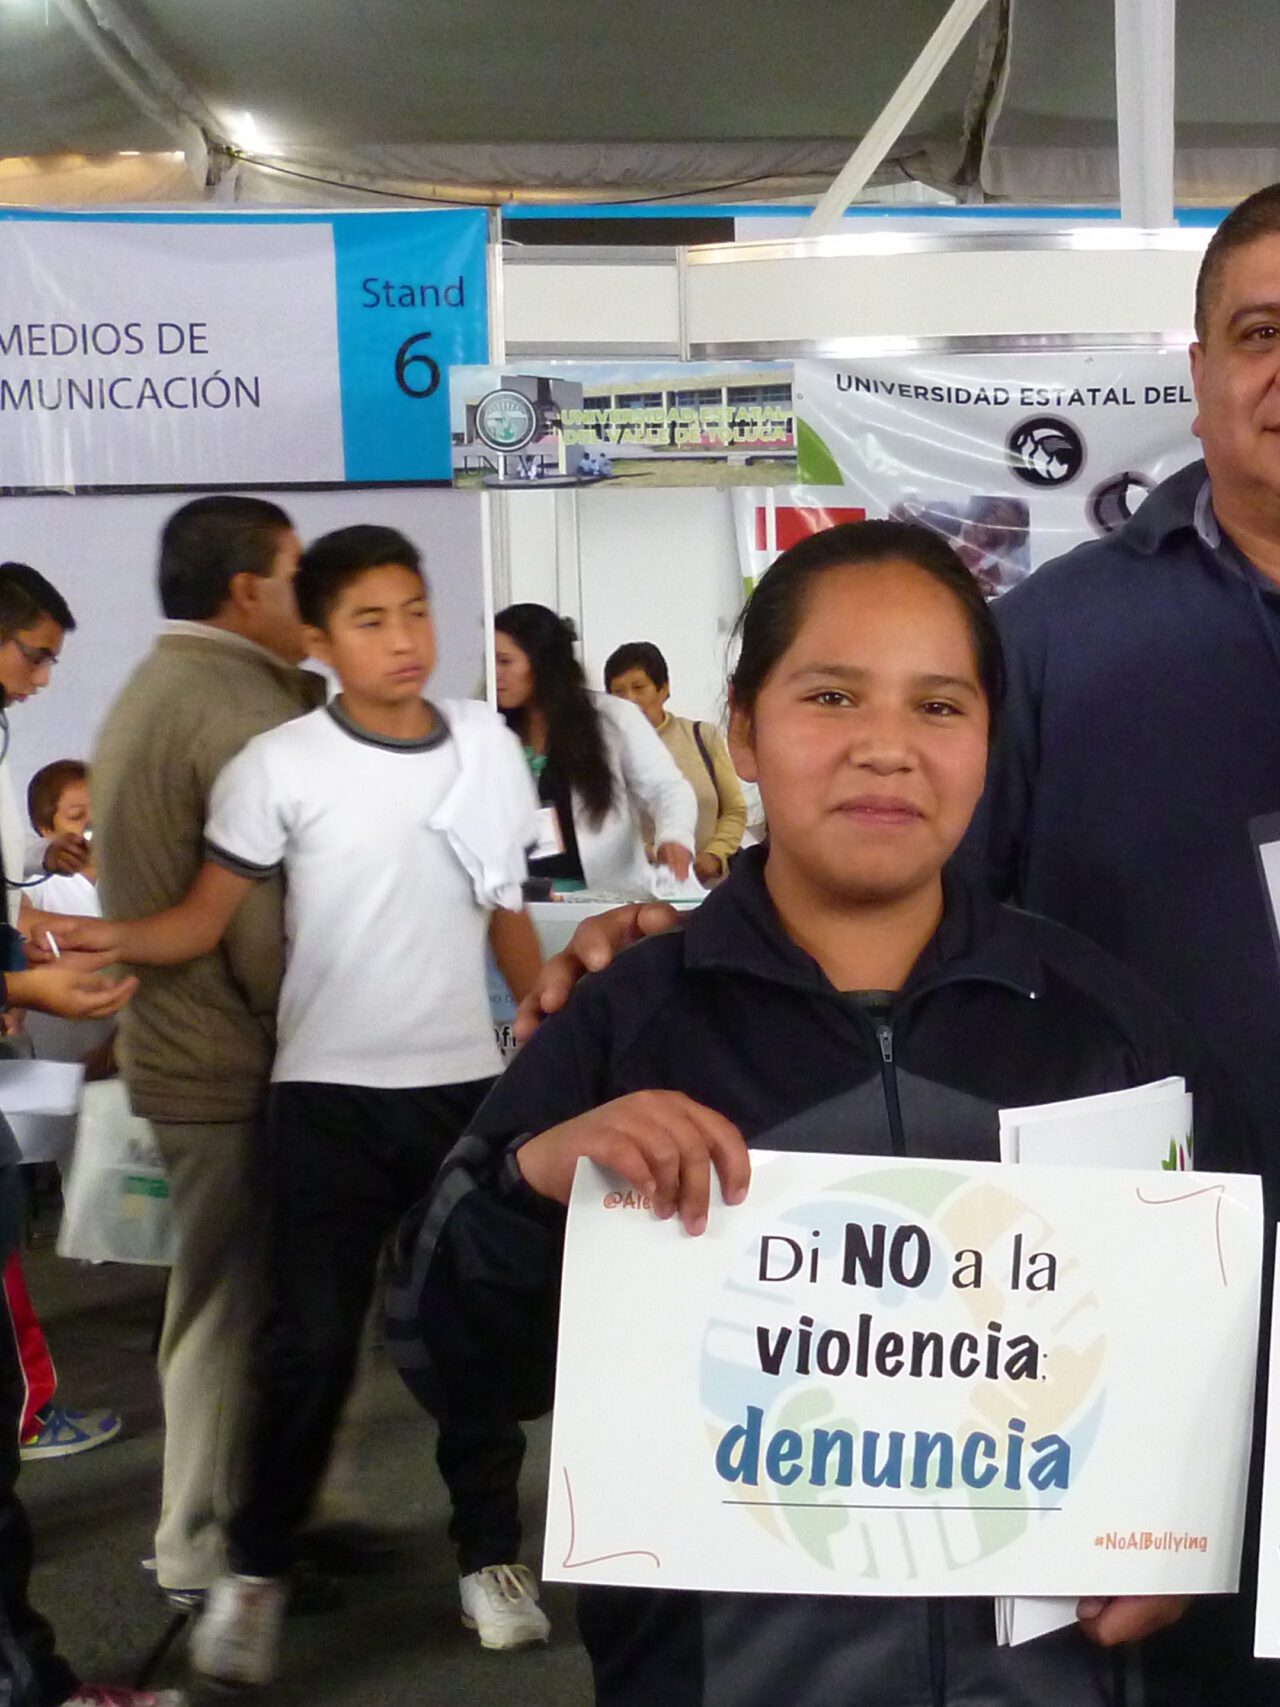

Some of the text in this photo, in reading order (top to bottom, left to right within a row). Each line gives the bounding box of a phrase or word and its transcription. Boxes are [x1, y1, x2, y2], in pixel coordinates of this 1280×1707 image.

[362, 275, 465, 308] Stand
[0, 322, 209, 356] MEDIOS DE
[394, 331, 442, 399] 6
[835, 373, 1193, 408] UNIVERSIDAD ESTATAL DEL
[603, 1190, 652, 1210] @Ale
[758, 1222, 1057, 1292] Di NO a la
[715, 1405, 1071, 1491] denuncia
